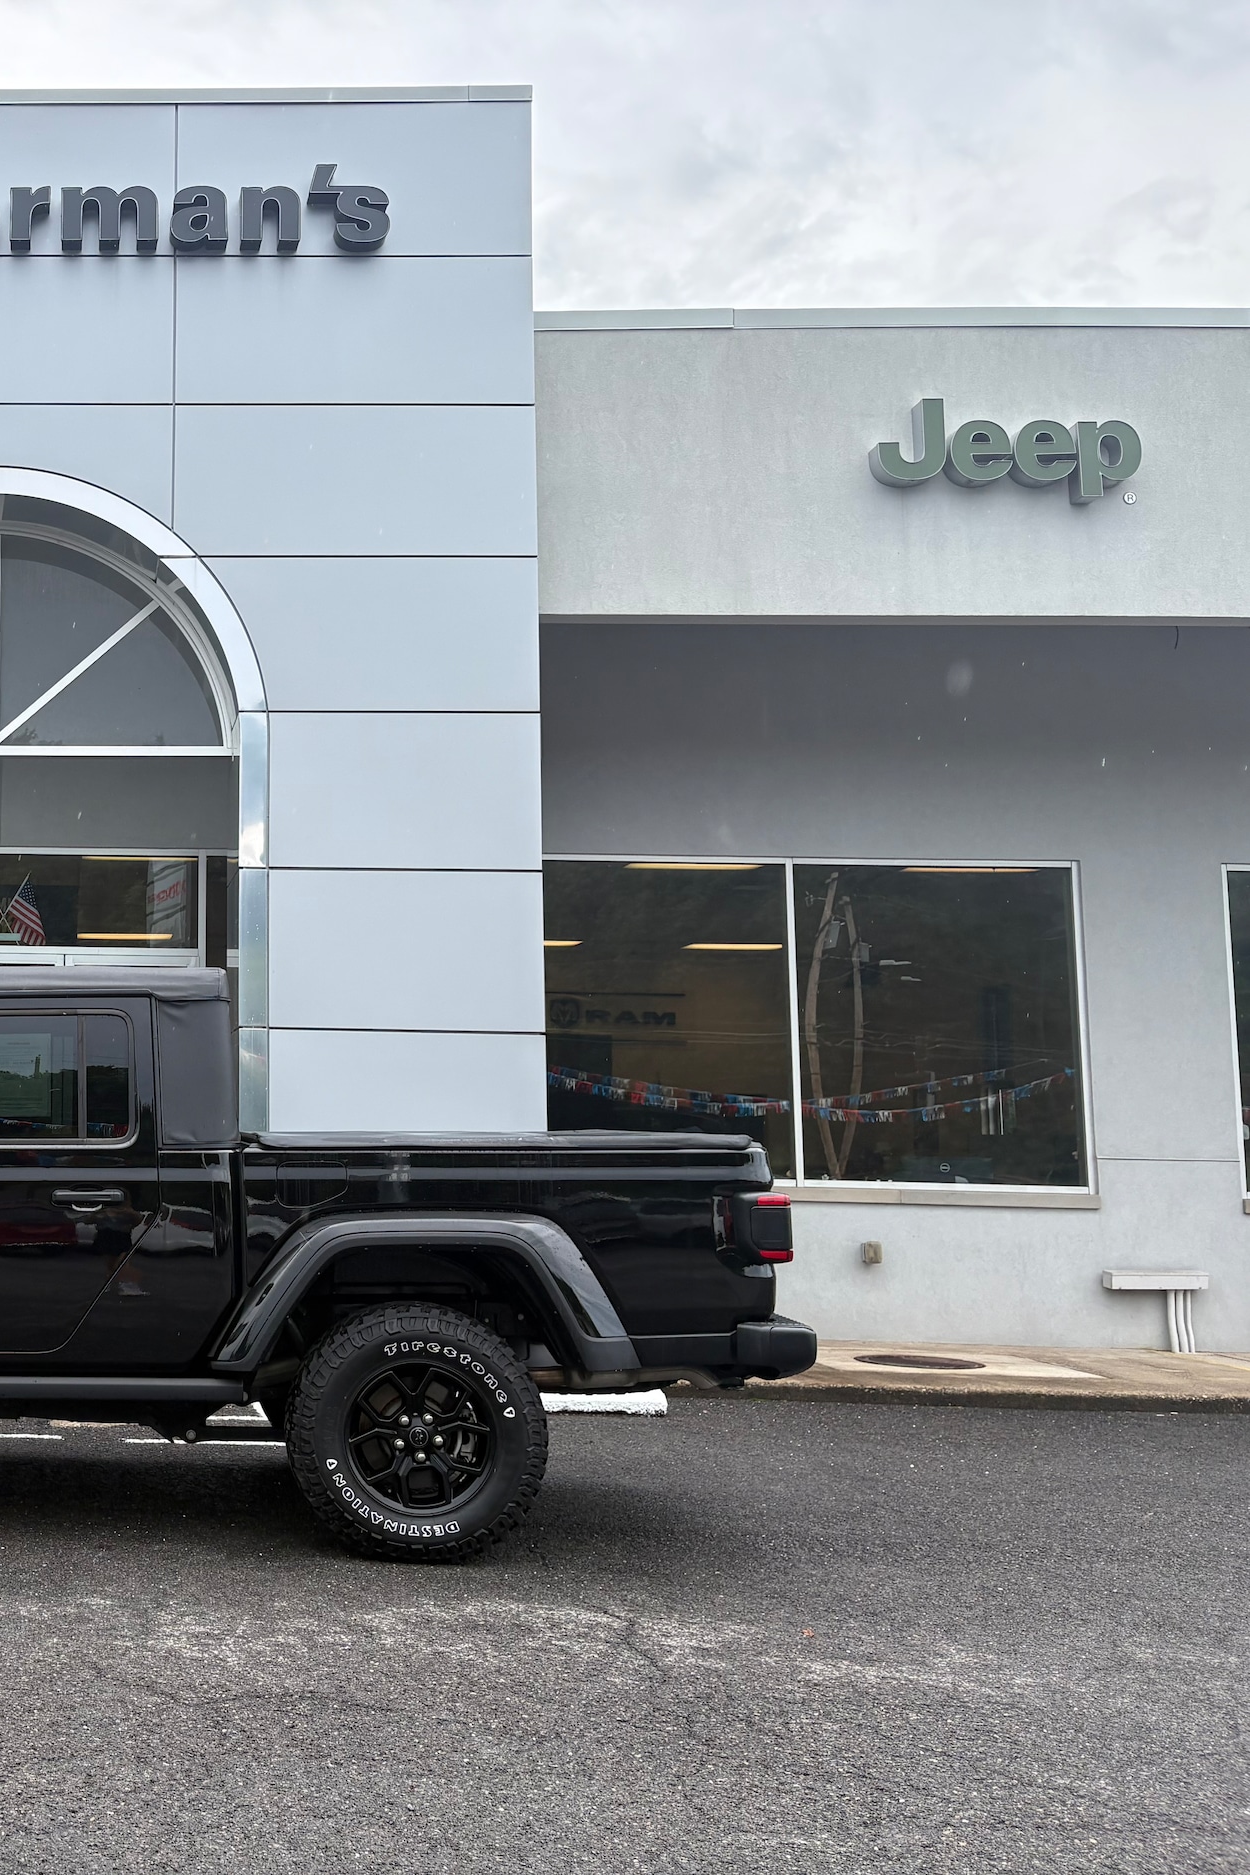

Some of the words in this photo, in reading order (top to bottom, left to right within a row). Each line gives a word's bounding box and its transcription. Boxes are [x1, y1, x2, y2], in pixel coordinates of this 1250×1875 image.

[868, 398, 1142, 503] Jeep
[585, 1009, 676, 1026] RAM
[383, 1340, 509, 1404] Firestone
[332, 1472, 461, 1538] DESTINATION
